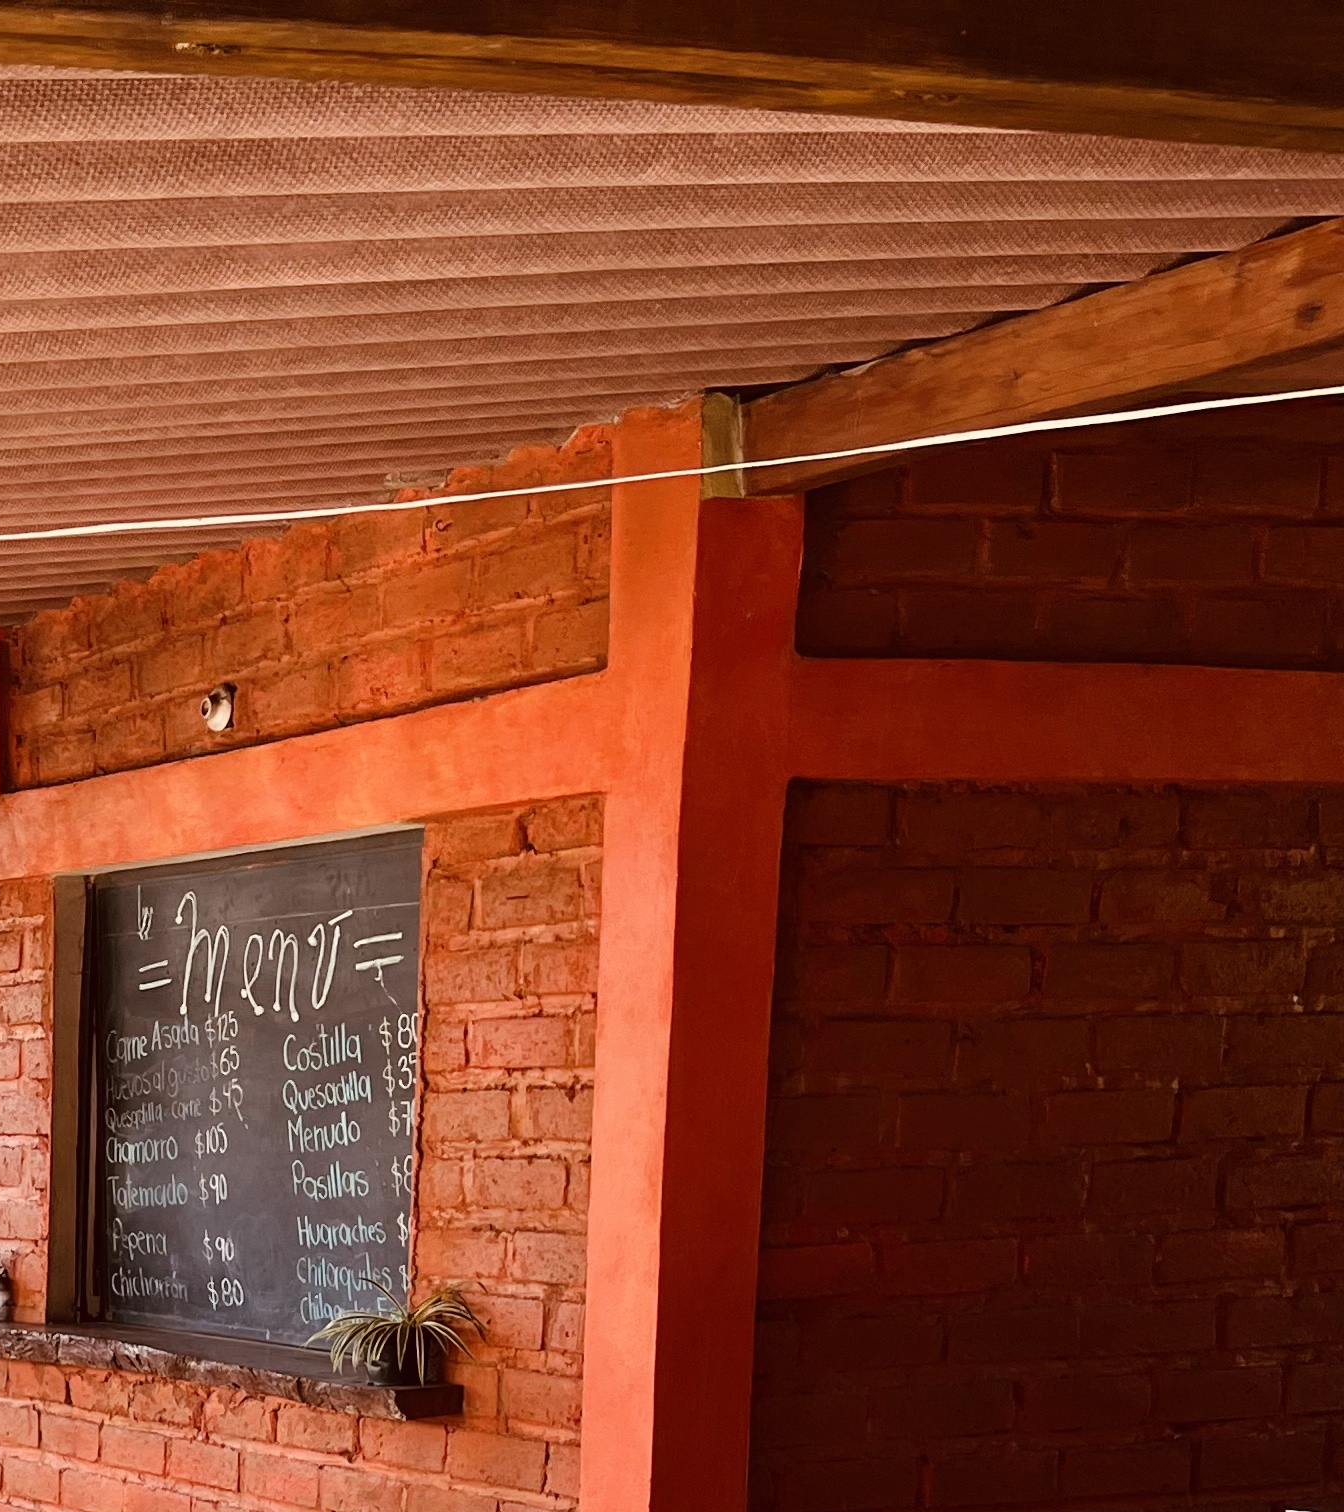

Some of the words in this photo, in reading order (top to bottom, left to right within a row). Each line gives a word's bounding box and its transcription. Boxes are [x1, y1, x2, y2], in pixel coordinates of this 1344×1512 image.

[106, 1030, 148, 1064] Carne
[151, 1014, 200, 1052] Asada
[204, 1010, 239, 1048] $125
[283, 1022, 362, 1072] Costilla
[106, 1074, 151, 1105] Huevos
[167, 1058, 210, 1098] gusto
[210, 1045, 240, 1081] $65
[283, 1071, 372, 1116] Quesadilla
[105, 1102, 164, 1132] Quesadilla
[287, 1111, 361, 1153] Menudo
[106, 1135, 179, 1164] Chamorro
[194, 1122, 228, 1159] $105
[108, 1174, 188, 1209] Tatemado
[198, 1172, 228, 1208] $90
[291, 1160, 370, 1203] Pasillas
[113, 1217, 168, 1261] Pepena
[202, 1229, 235, 1265] $90
[297, 1214, 387, 1250] Huaraches
[206, 1276, 245, 1311] $80
[296, 1251, 392, 1301] Chilaquiles
